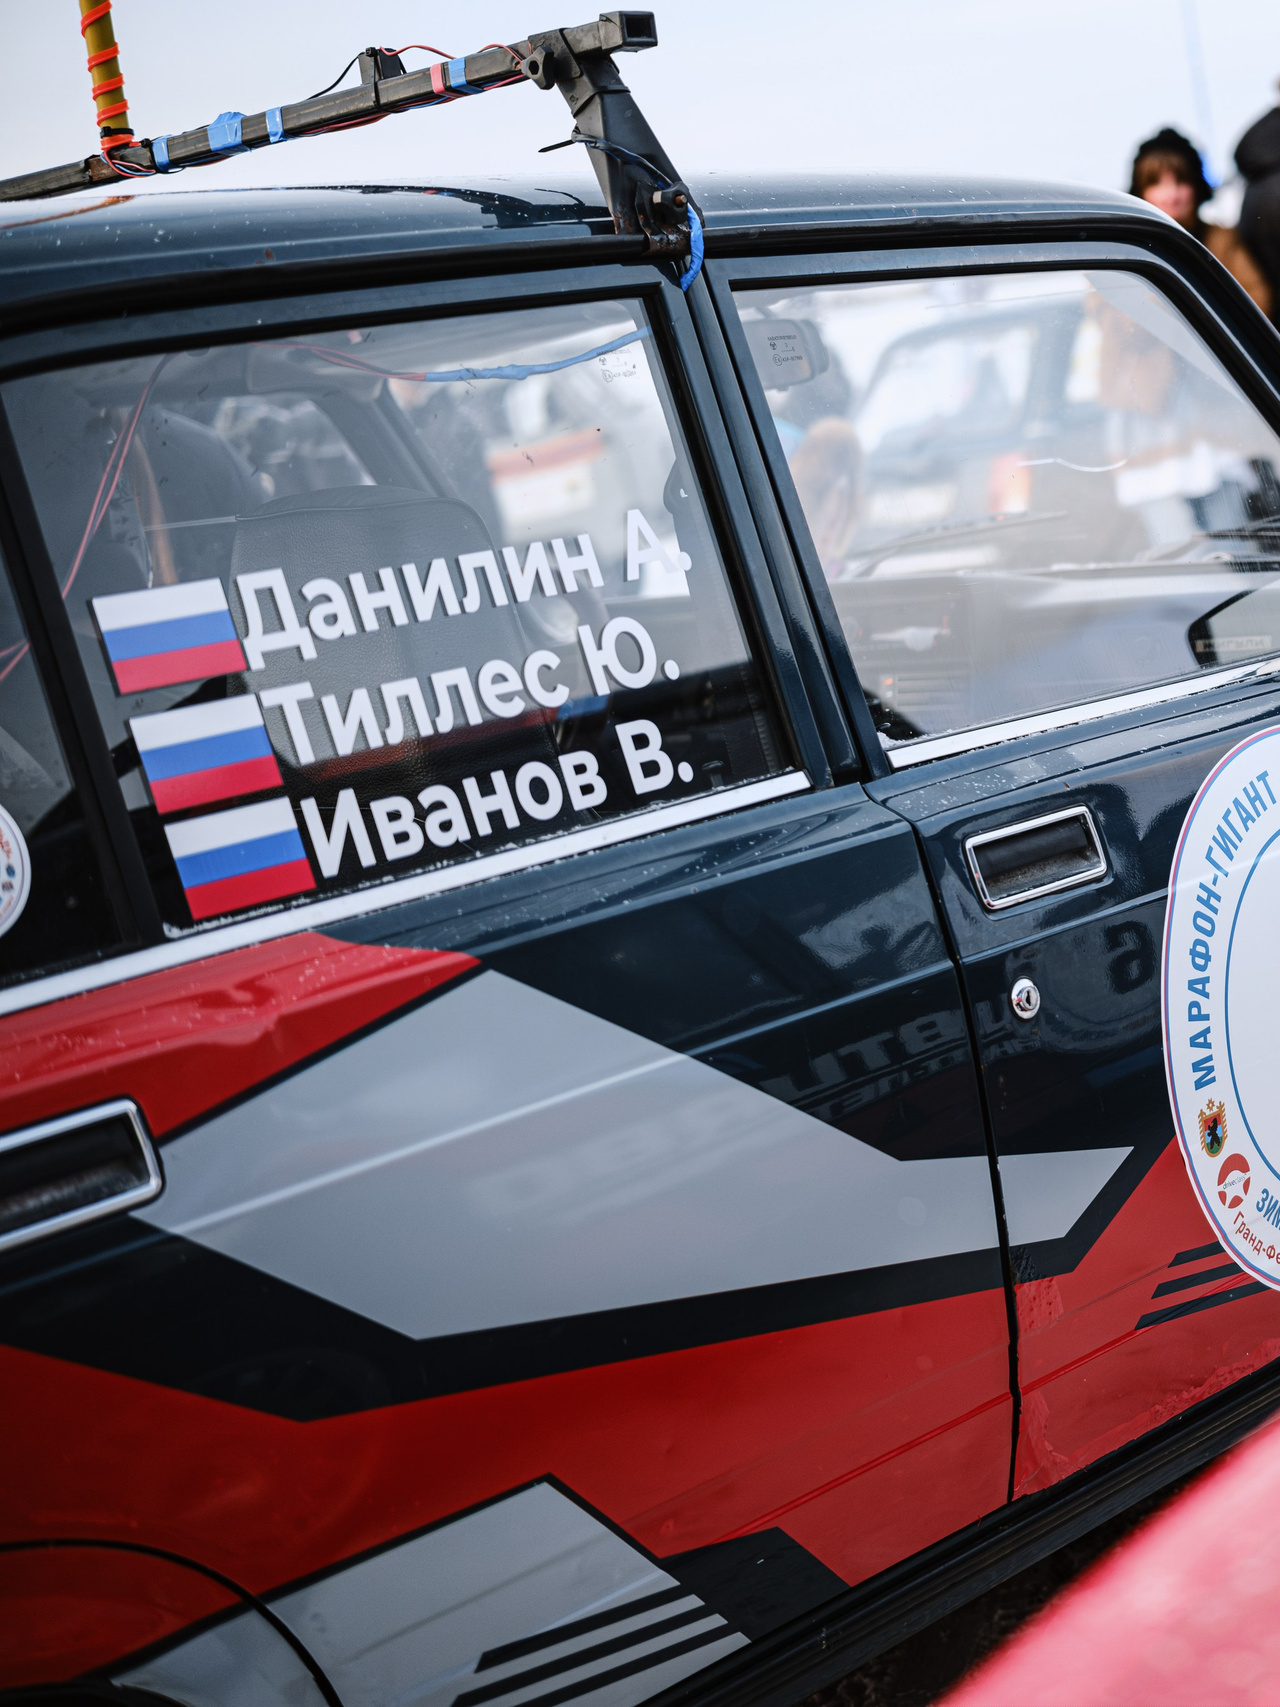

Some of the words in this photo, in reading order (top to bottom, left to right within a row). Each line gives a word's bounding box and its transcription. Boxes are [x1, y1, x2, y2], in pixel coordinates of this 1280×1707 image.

[236, 532, 604, 670] Данилин
[625, 509, 692, 581] А.
[259, 645, 570, 766] Тиллес
[577, 616, 680, 697] Ю.
[300, 749, 608, 879] Иванов
[615, 719, 694, 796] В.
[1188, 770, 1277, 1091] МАРАФОН-ГИГАНТ
